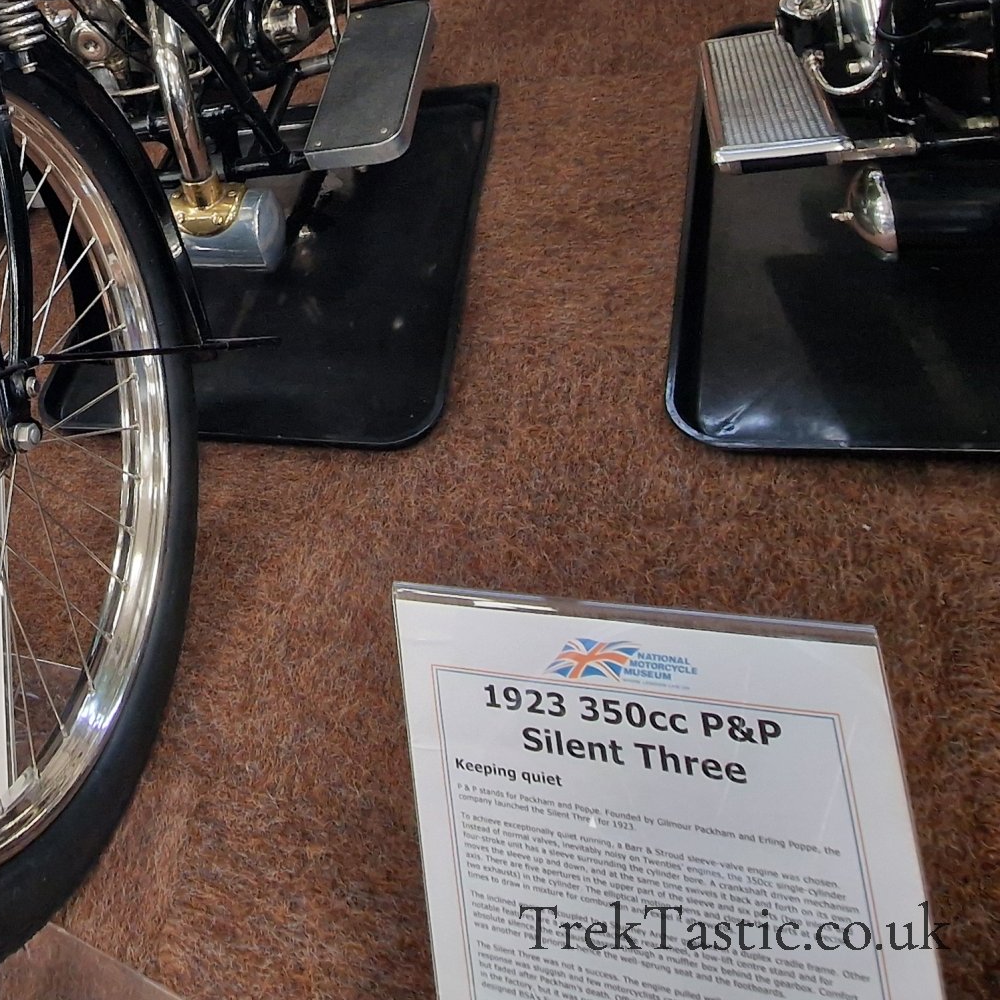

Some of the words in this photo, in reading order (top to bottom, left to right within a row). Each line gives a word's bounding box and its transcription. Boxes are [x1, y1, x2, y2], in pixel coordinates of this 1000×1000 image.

[629, 660, 698, 675] MOTORCYCLE
[637, 652, 691, 666] NATIONAL
[623, 667, 672, 681] MUSEUM
[483, 683, 567, 718] 1923
[578, 695, 689, 734] 350cc
[700, 711, 784, 747] P&P
[521, 725, 625, 765] Silent
[633, 741, 748, 784] Three
[455, 757, 516, 781] Keeping
[521, 768, 563, 789] quiet
[531, 804, 544, 814] the
[546, 807, 569, 819] Silent
[572, 812, 595, 823] Thre
[557, 801, 572, 809] and
[738, 832, 755, 841] and
[823, 844, 841, 856] the
